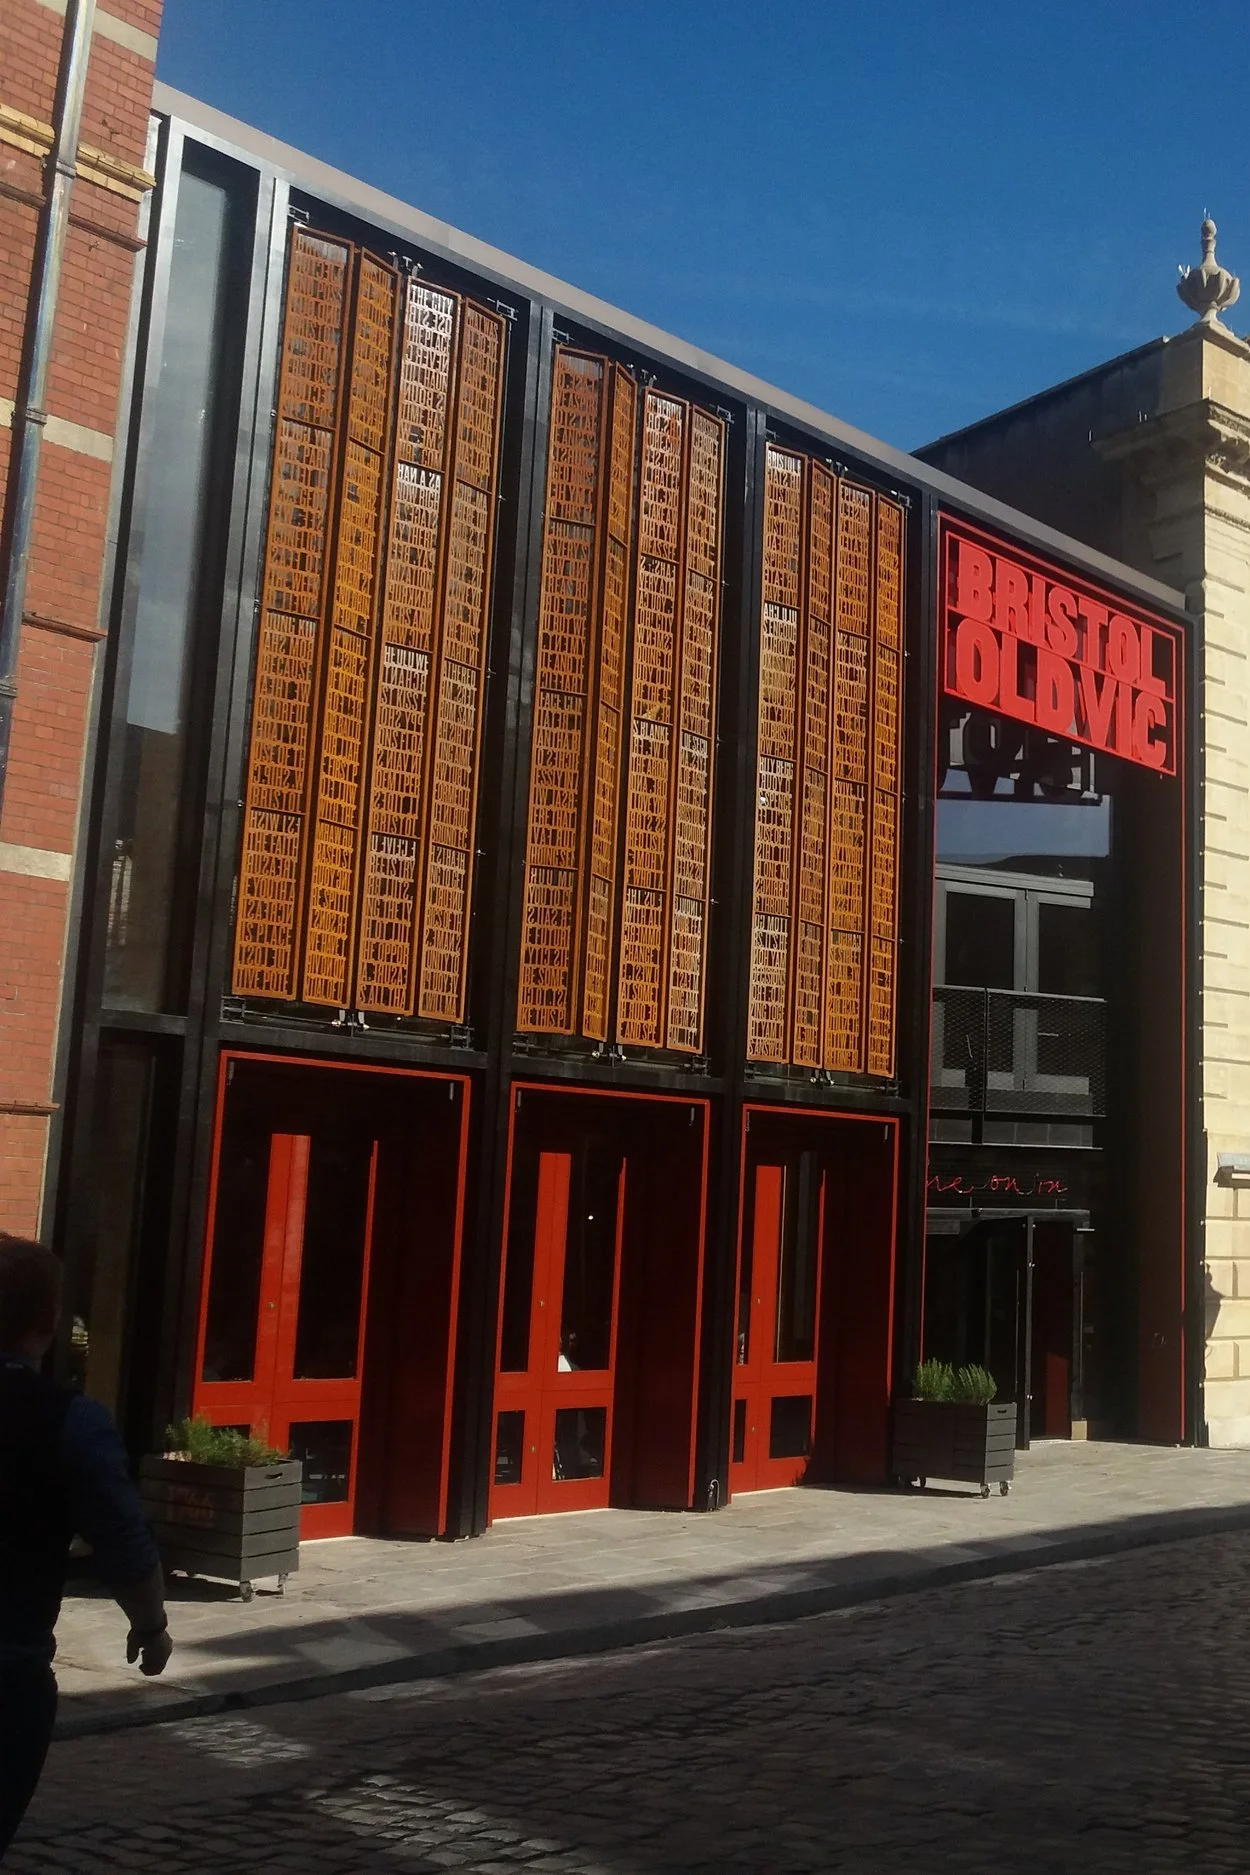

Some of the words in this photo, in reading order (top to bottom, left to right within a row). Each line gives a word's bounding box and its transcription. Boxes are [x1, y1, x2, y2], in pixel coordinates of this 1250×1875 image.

[955, 617, 1075, 734] OLD
[1076, 664, 1167, 768] VIC
[957, 541, 1166, 696] BRISTOL
